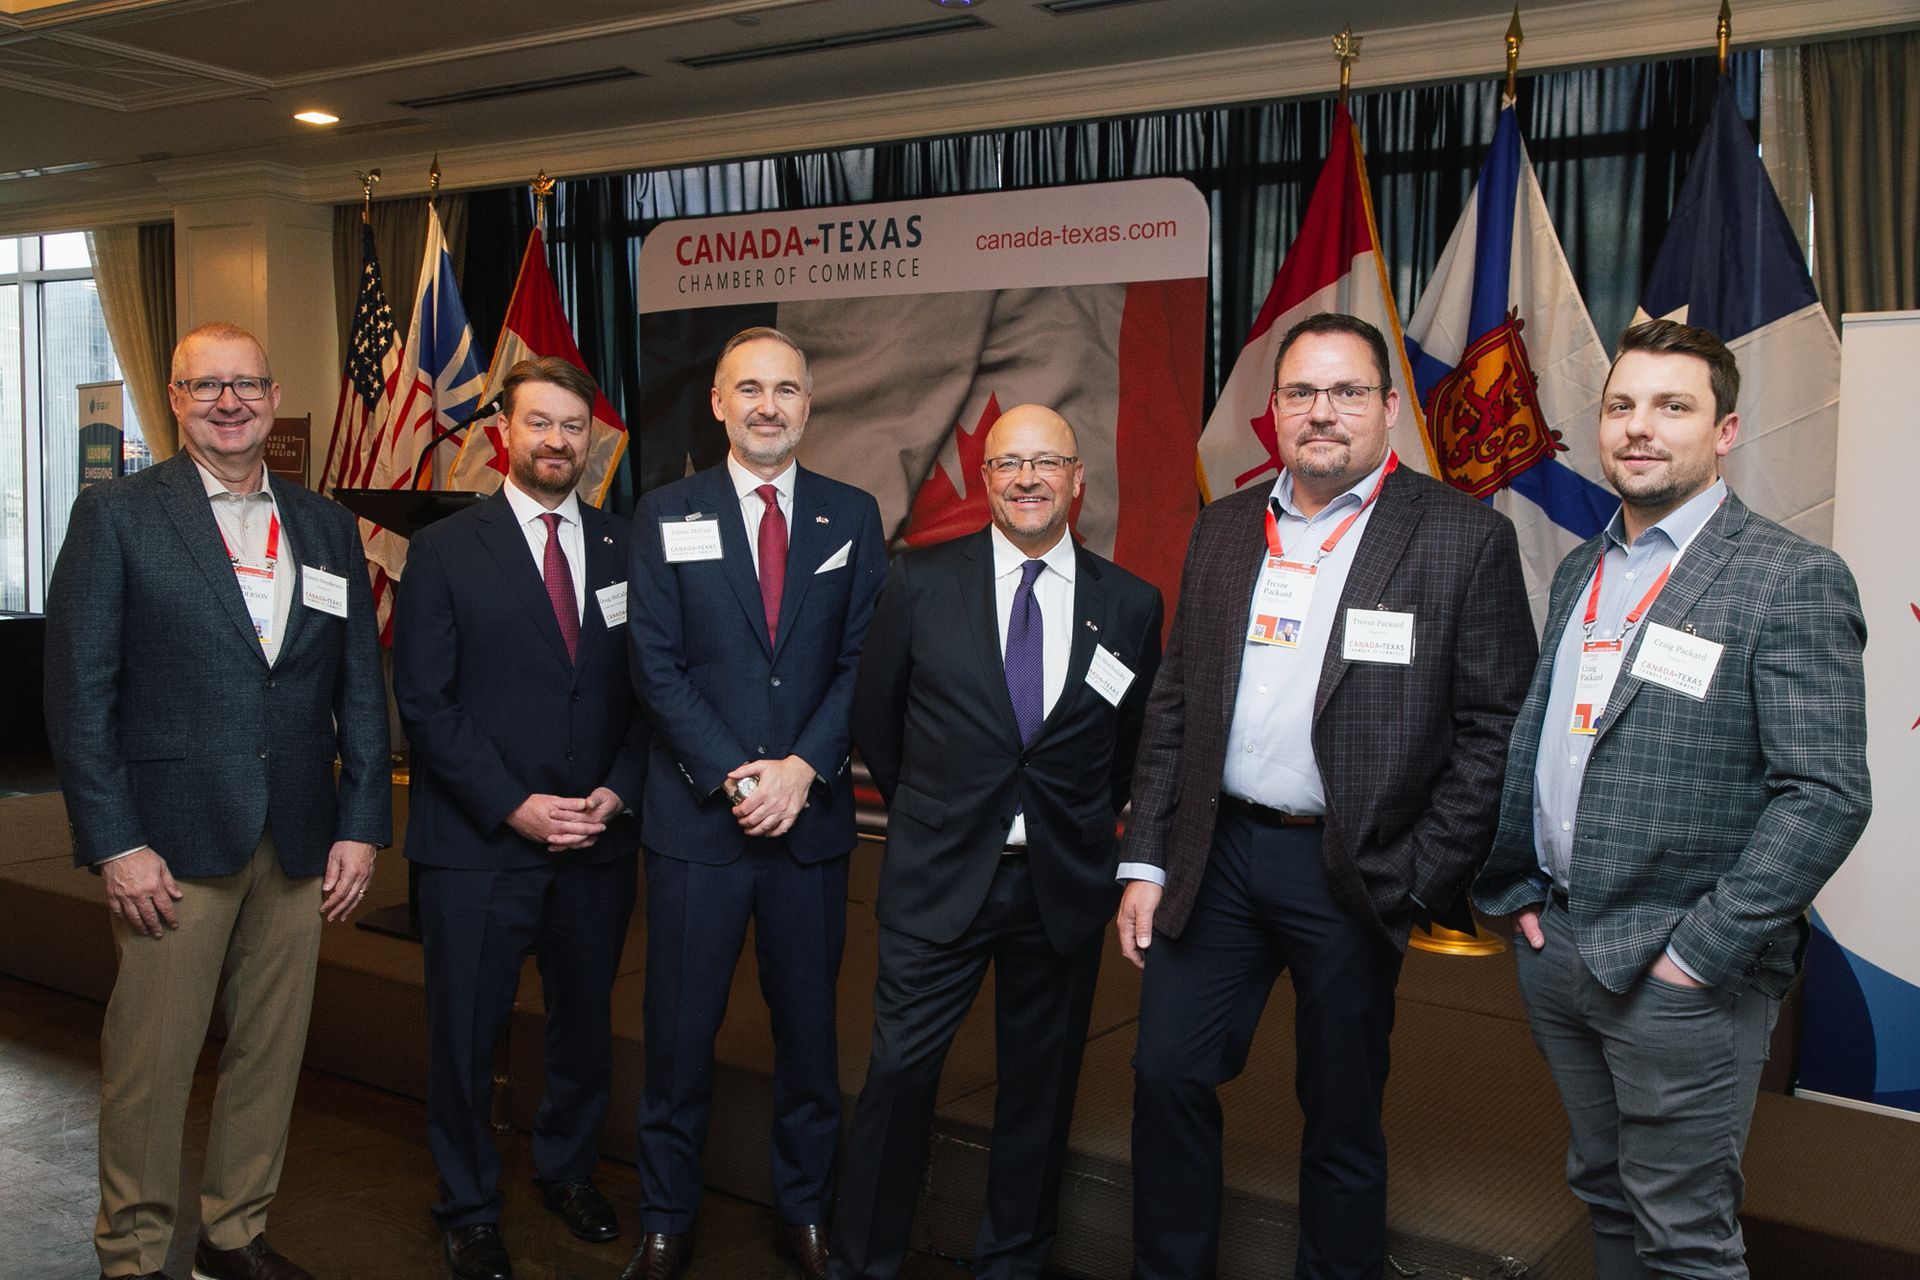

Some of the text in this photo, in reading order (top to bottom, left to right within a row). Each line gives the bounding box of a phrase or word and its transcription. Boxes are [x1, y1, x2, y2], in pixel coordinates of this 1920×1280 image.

[676, 215, 922, 266] CANADA TEXAS
[976, 220, 1177, 250] canada-texas.com
[678, 258, 920, 294] CHAMBER OF COMMERCE
[268, 435, 296, 443] ARGEST
[87, 447, 112, 460] LEADING
[85, 467, 113, 480] EMISSIONS
[1266, 579, 1288, 589] Trevor
[1263, 587, 1292, 598] Packard
[1353, 618, 1404, 628] Trevor Packard
[1349, 640, 1405, 651] CANADA TEXAS
[1654, 638, 1675, 652] Craig
[1676, 644, 1708, 661] Packard
[1581, 664, 1597, 673] Craig
[1641, 660, 1703, 687] CANADA TEXAS
[1580, 673, 1603, 681] Packard
